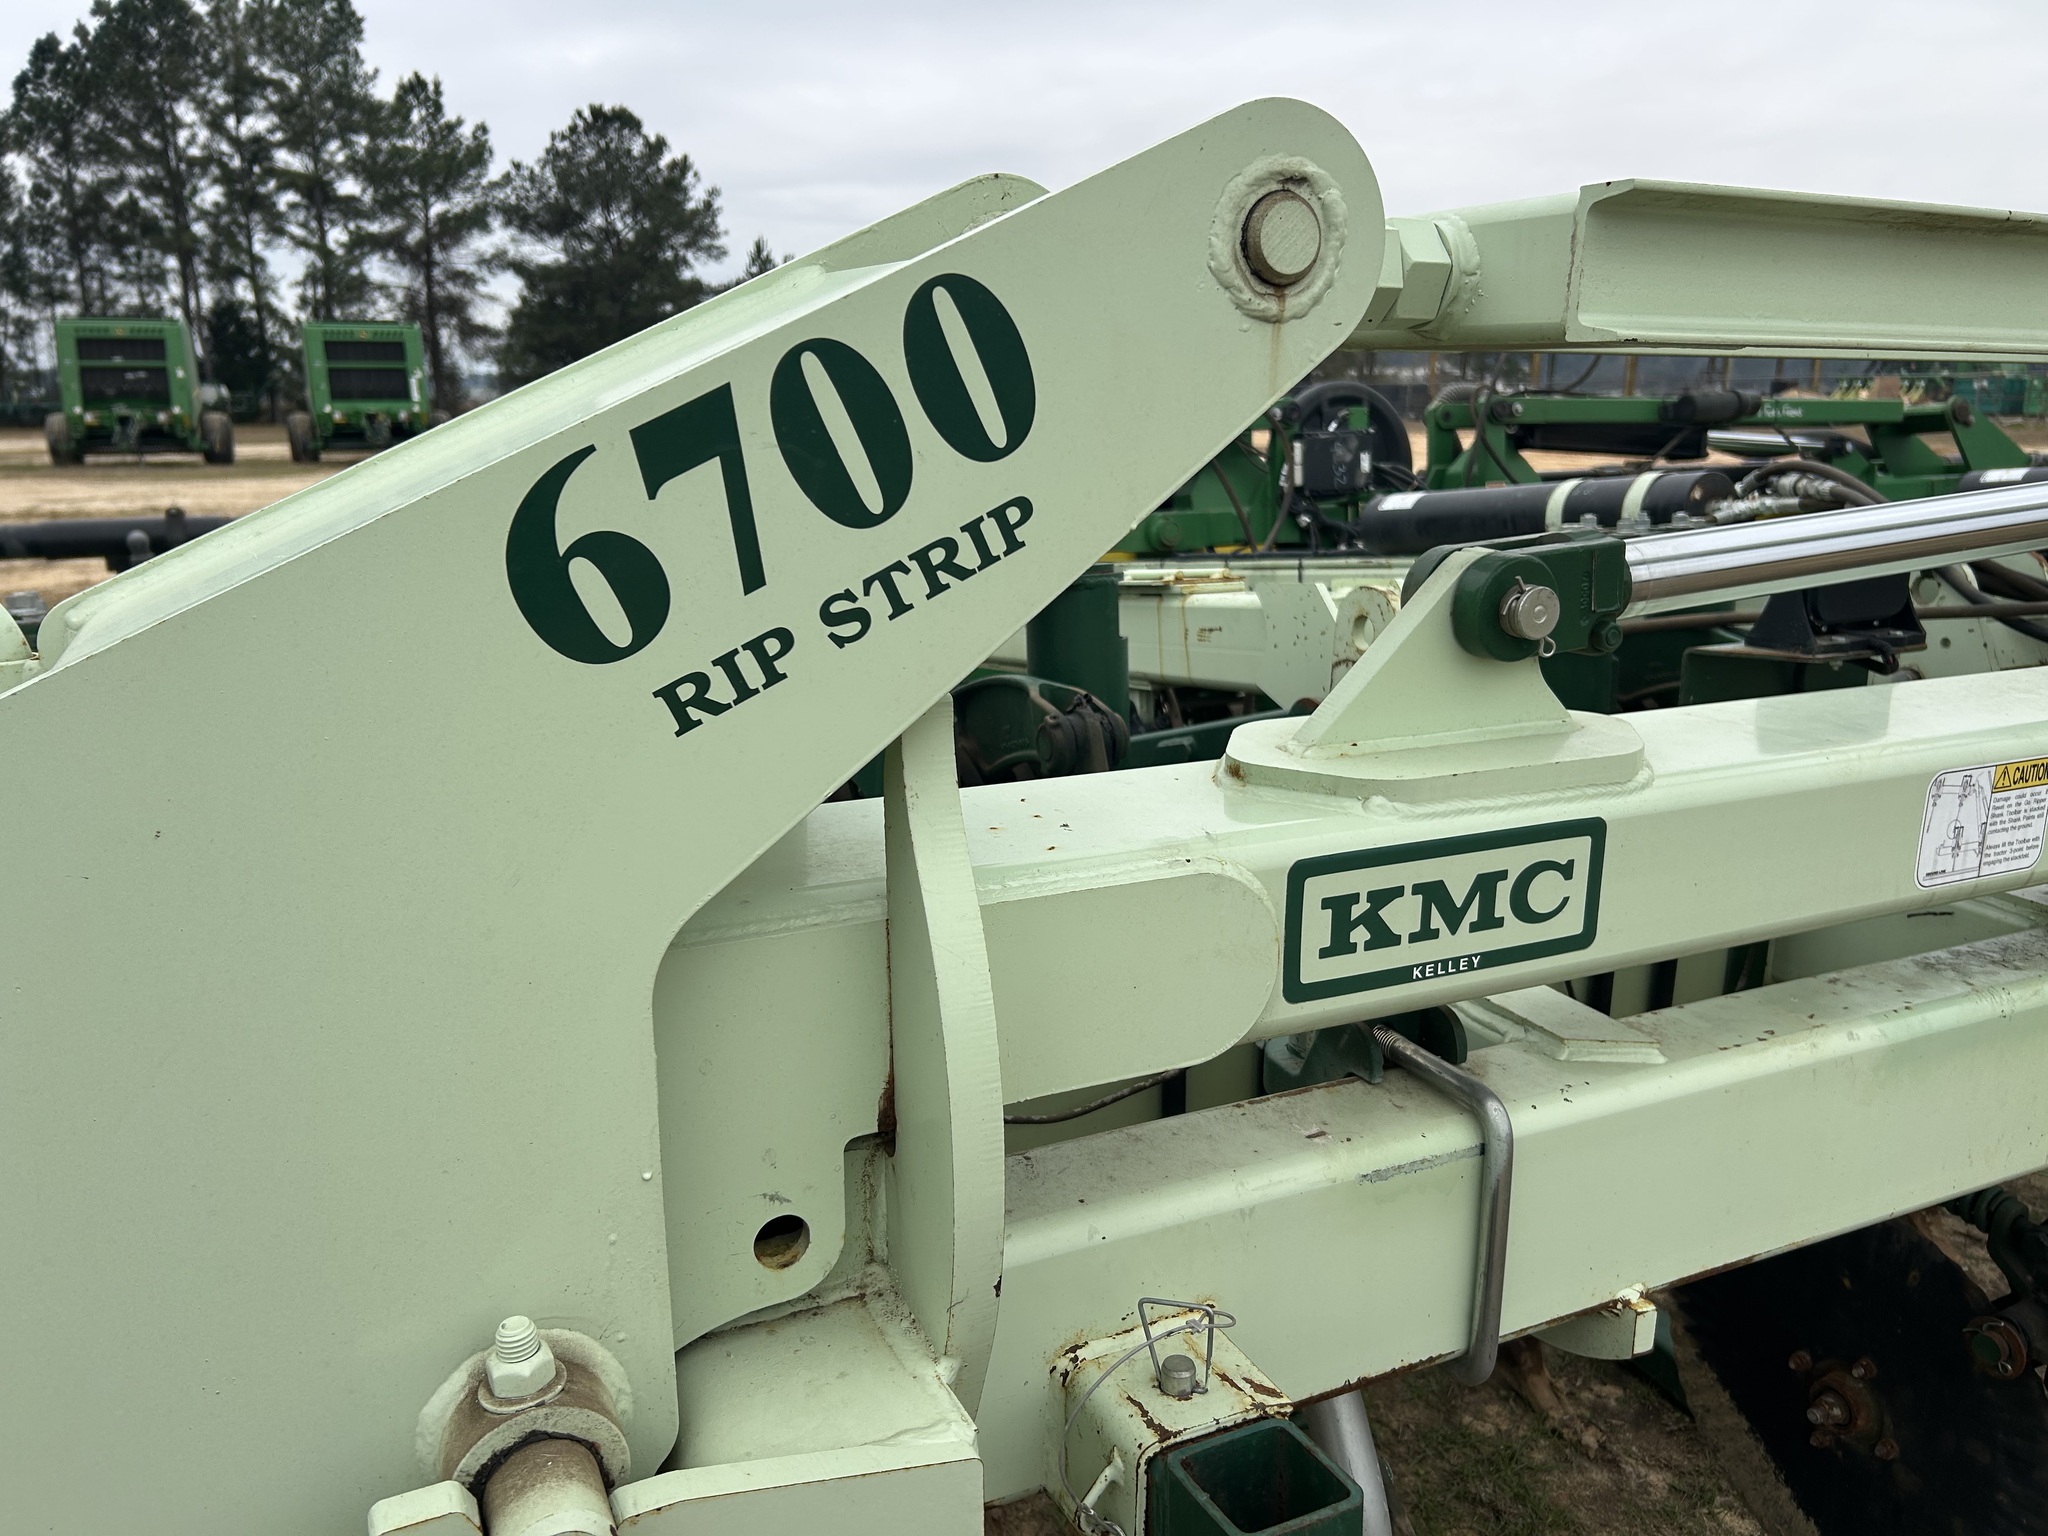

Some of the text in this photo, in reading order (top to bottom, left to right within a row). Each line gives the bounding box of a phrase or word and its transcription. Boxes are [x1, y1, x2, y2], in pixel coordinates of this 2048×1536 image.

[505, 272, 1036, 665] 6700
[652, 495, 1034, 738] RIP STRIP
[2012, 762, 2048, 785] CAUTION
[1318, 858, 1575, 960] KMC
[1412, 955, 1482, 980] KELLEY
